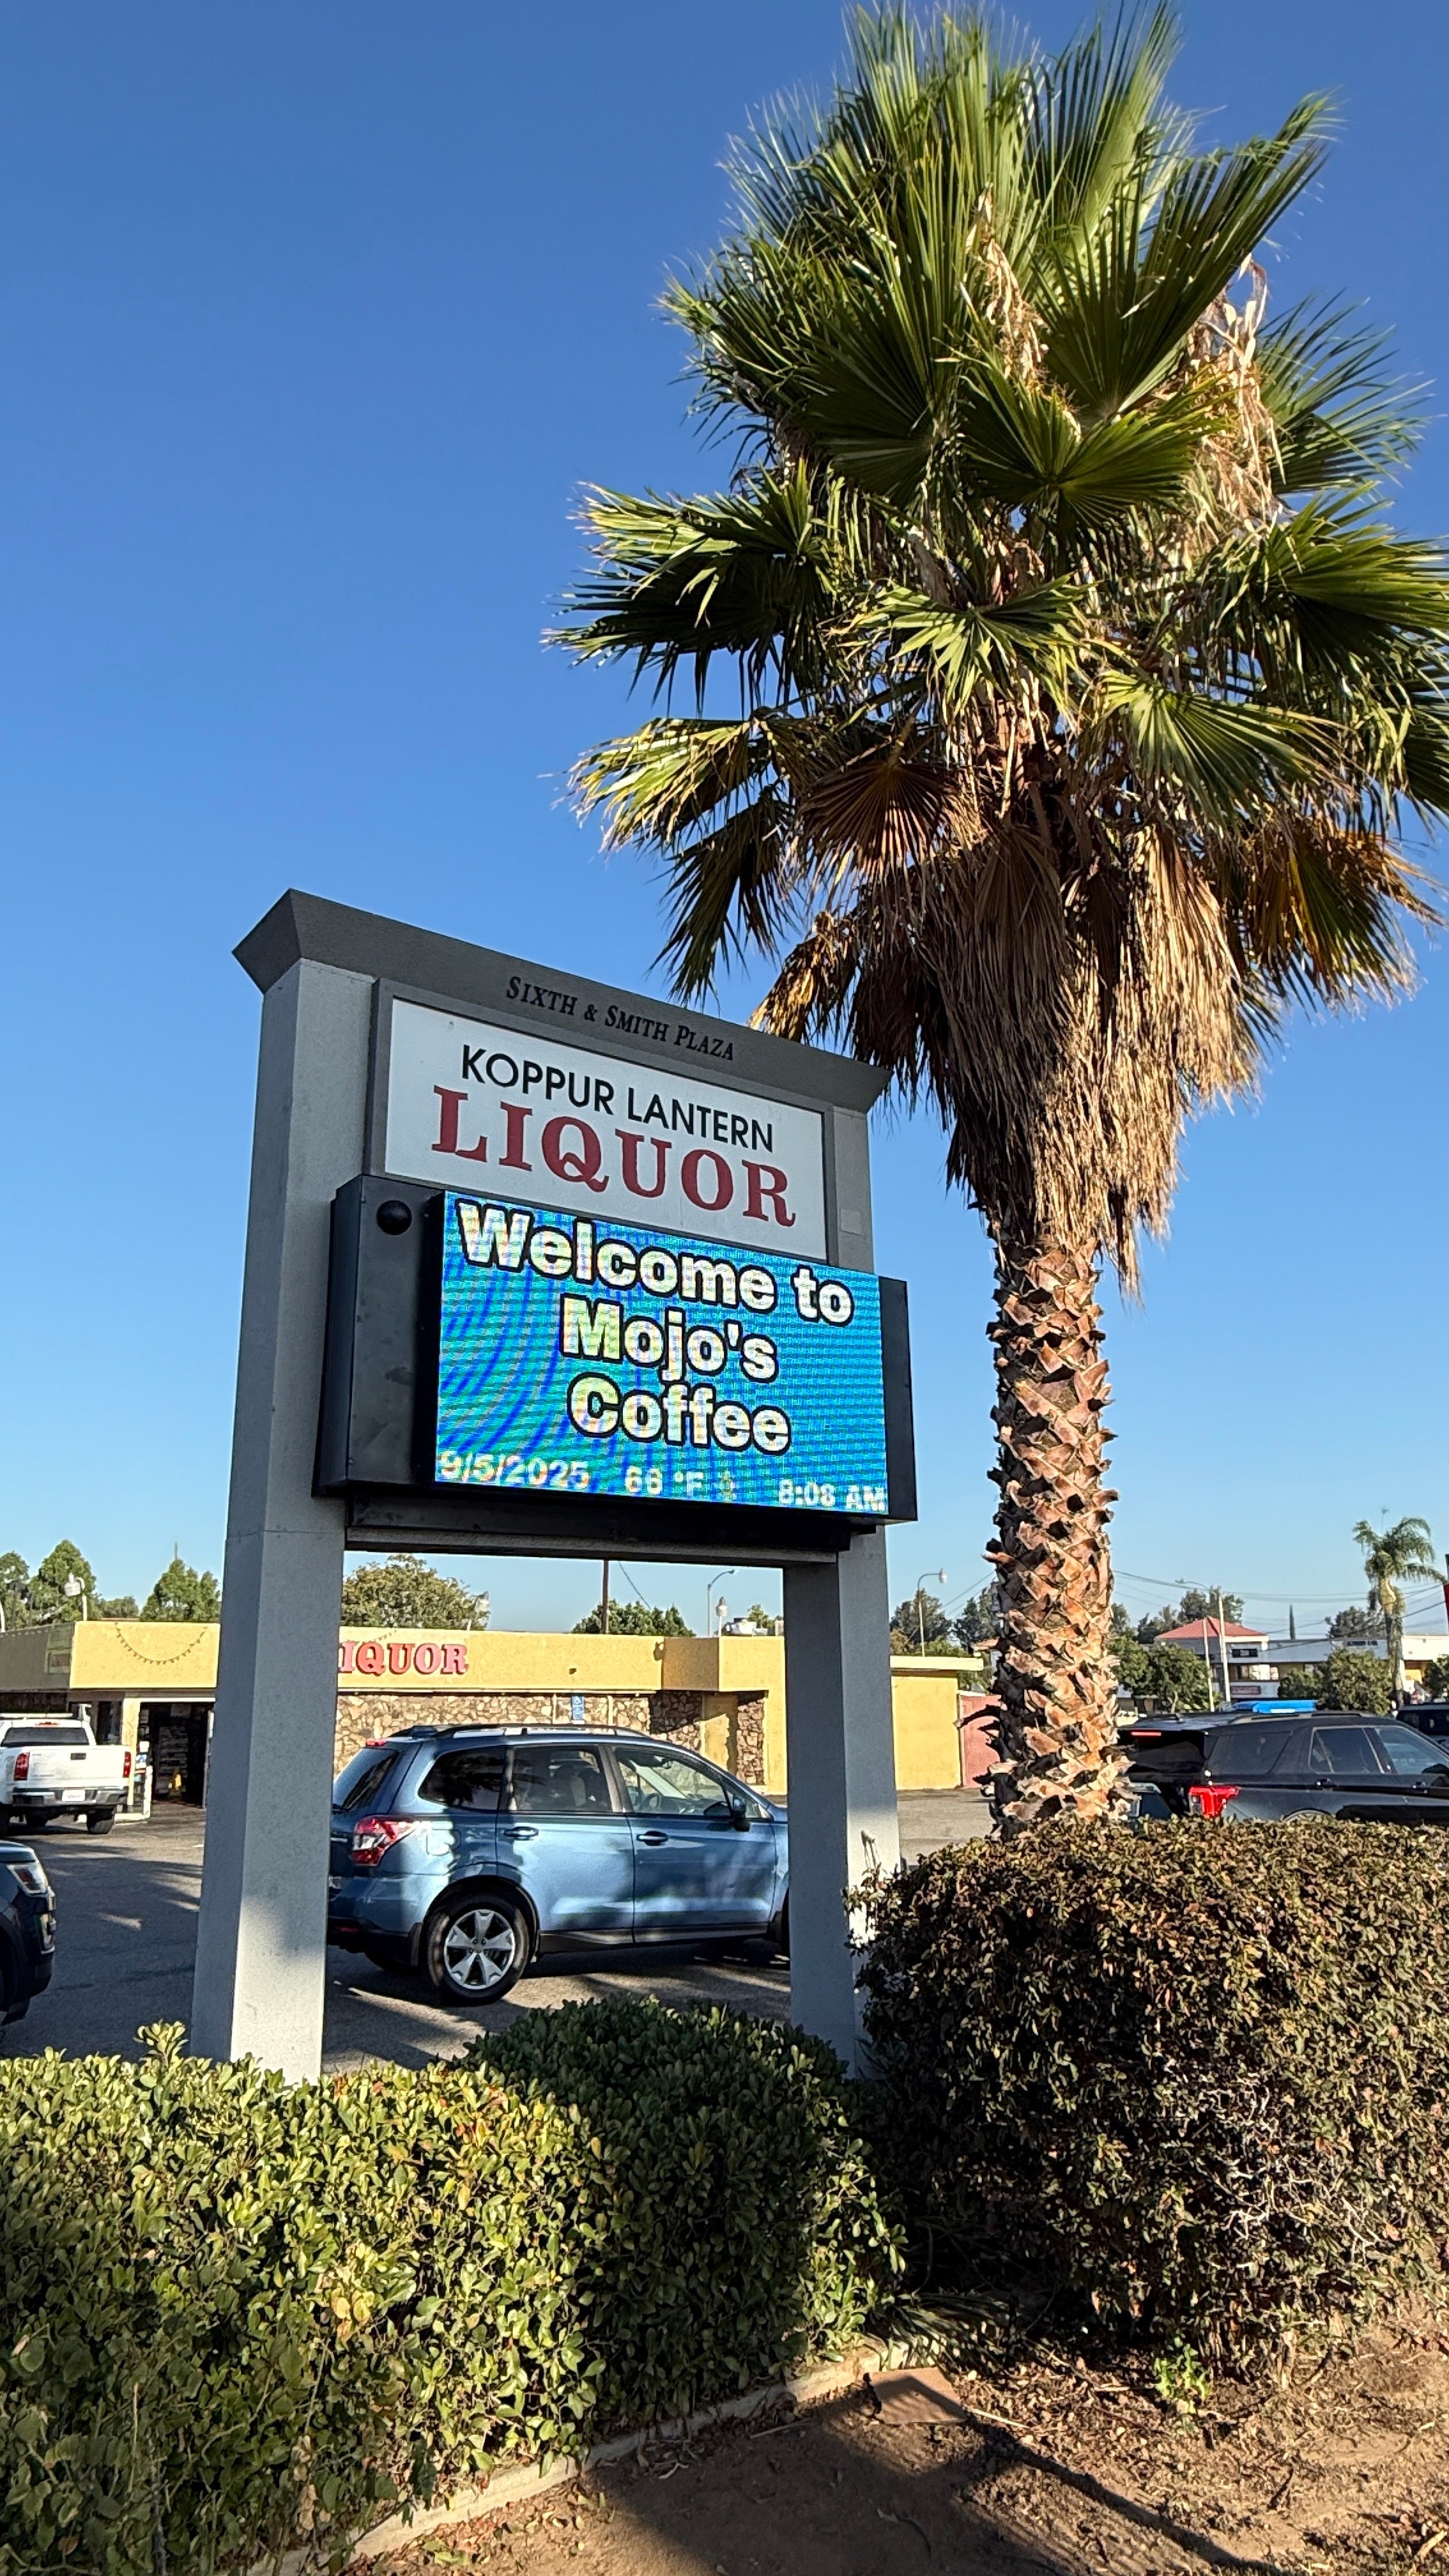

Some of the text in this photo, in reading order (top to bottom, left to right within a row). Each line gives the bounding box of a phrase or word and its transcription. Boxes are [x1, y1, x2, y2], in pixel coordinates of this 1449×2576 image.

[505, 976, 734, 1061] SIXTH & SMITH PLAZA
[461, 1043, 773, 1153] KOPPUR LANTERN
[432, 1084, 796, 1227] LIQUOR
[457, 1200, 854, 1325] Welcome to
[561, 1296, 778, 1382] Mojo's
[569, 1374, 791, 1453] Coffee
[440, 1451, 591, 1490] 9/5/2025
[625, 1466, 663, 1495] 66
[778, 1478, 836, 1506] 8:08
[846, 1485, 885, 1512] AM
[339, 1639, 470, 1676] IQUOR
